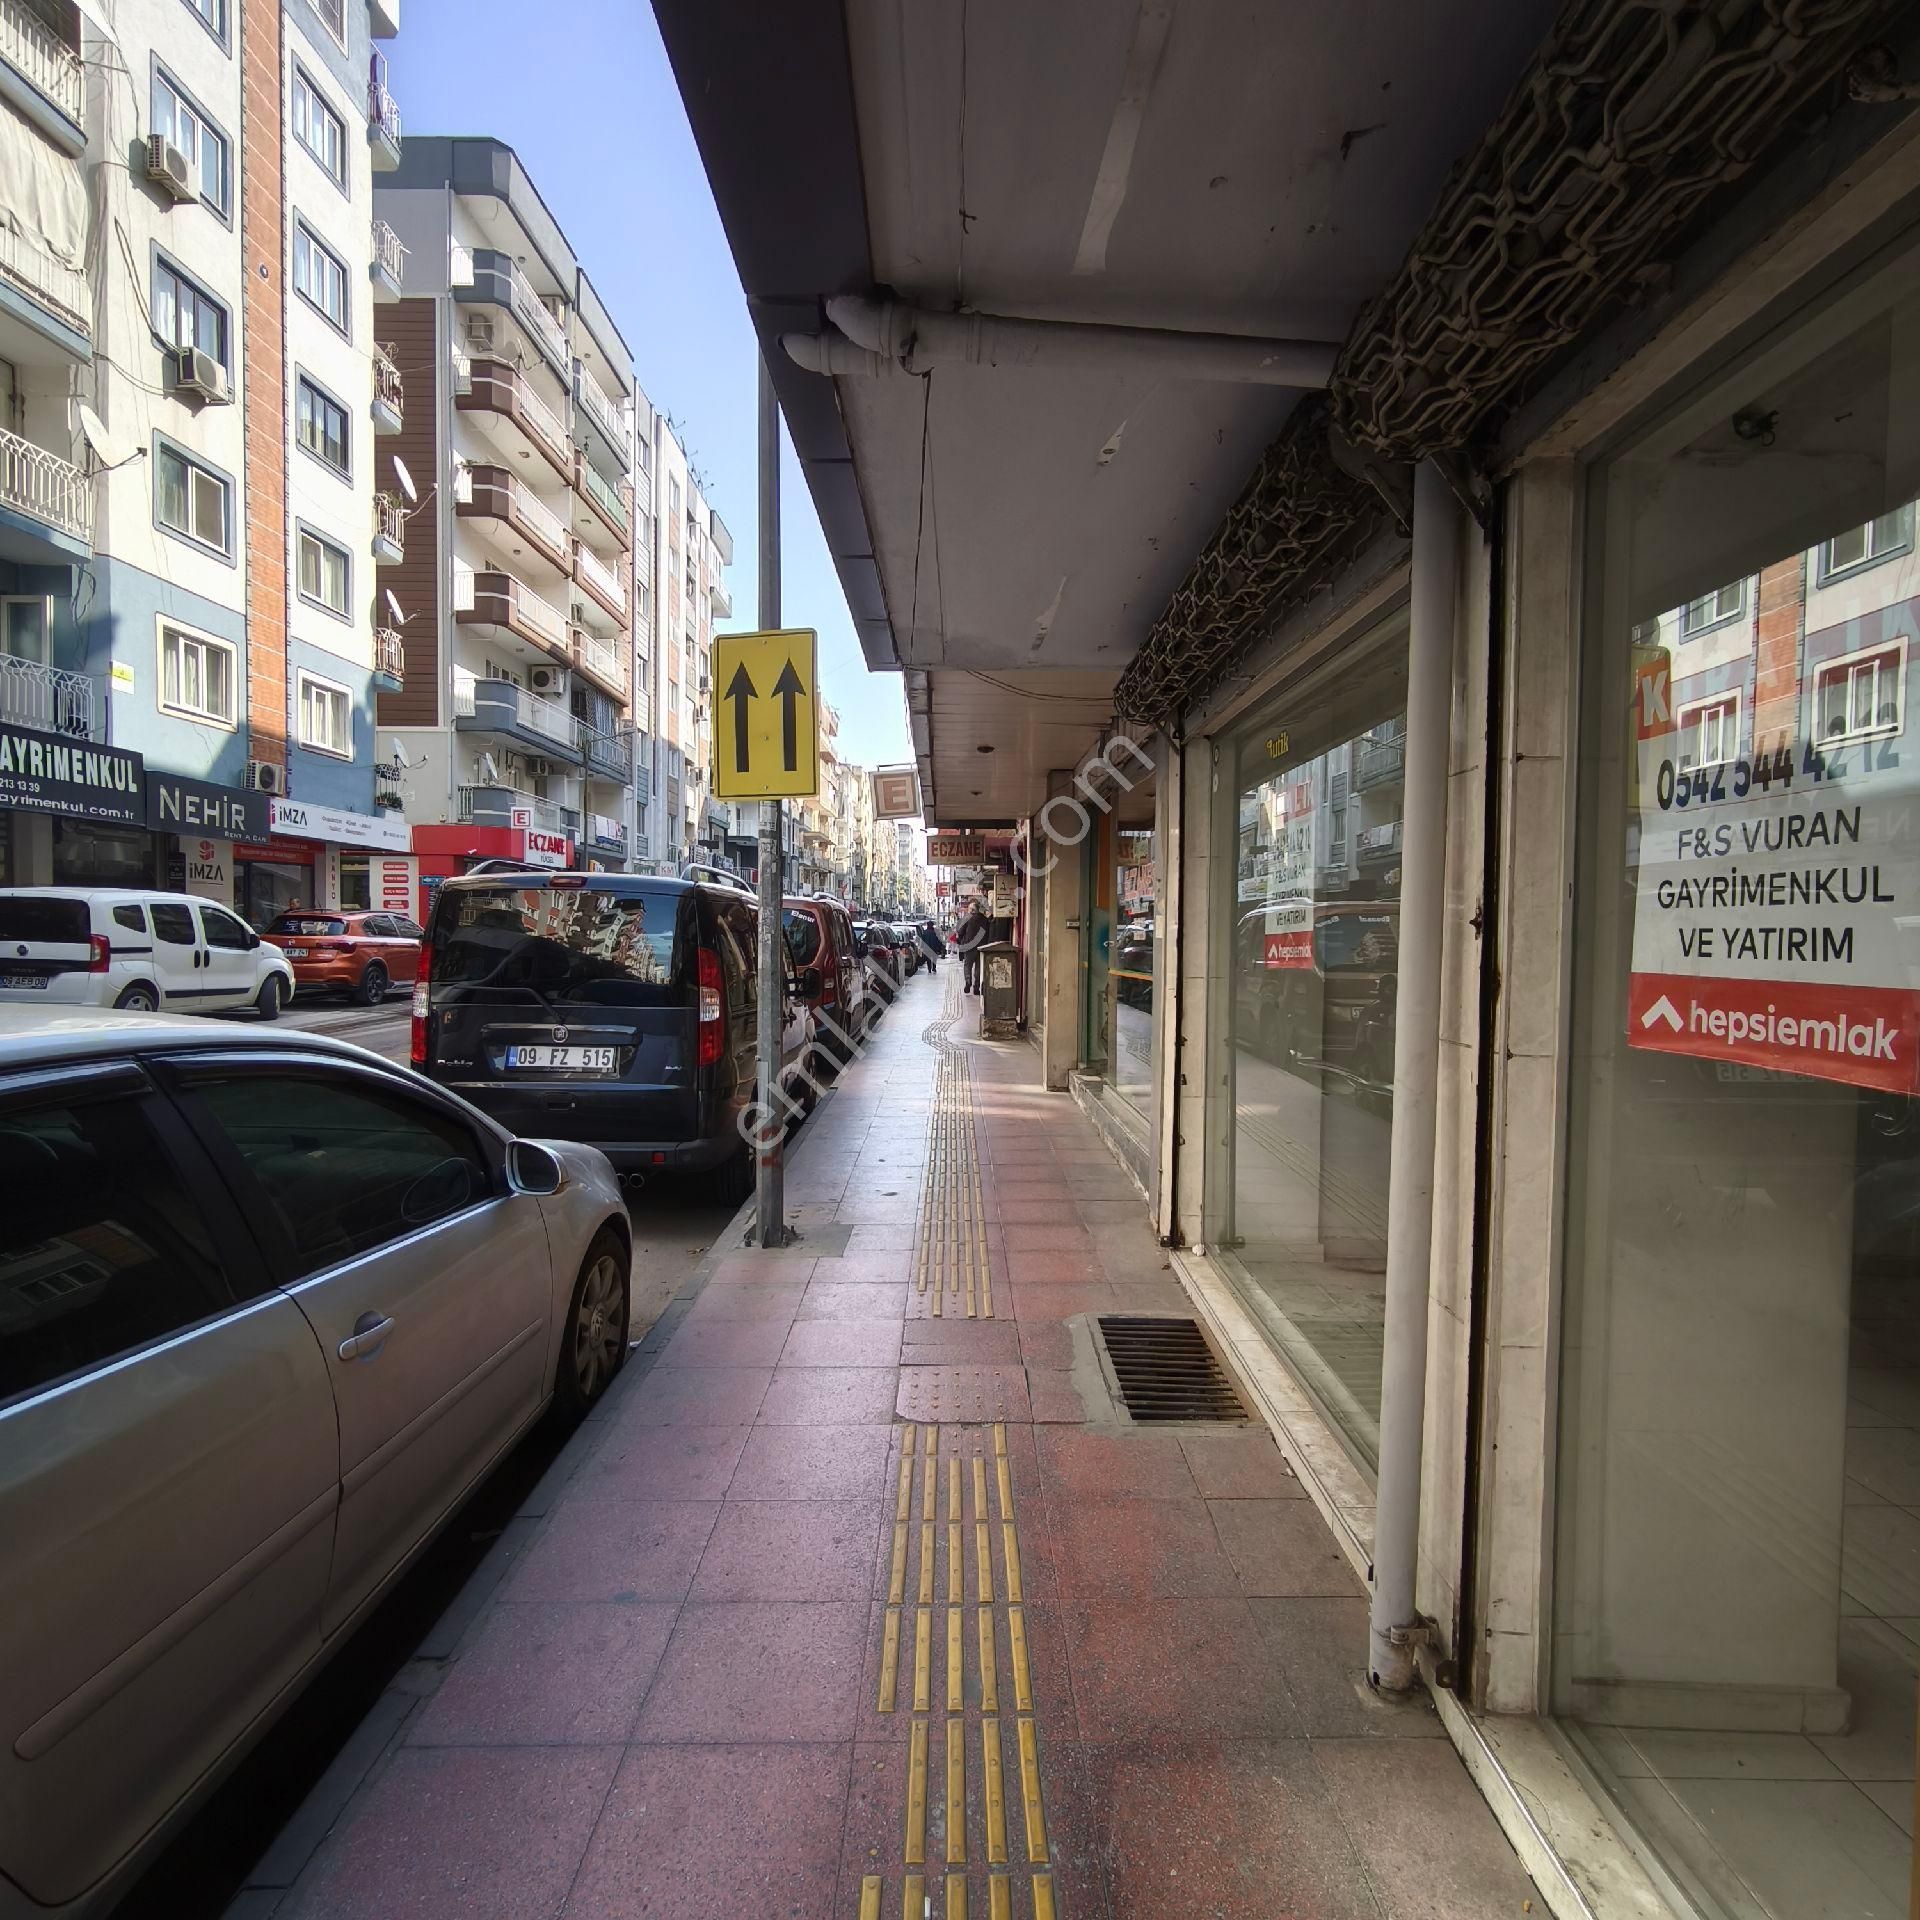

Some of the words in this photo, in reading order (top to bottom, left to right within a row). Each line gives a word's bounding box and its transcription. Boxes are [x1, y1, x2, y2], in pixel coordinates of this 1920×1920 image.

[17, 780, 27, 791] 13
[29, 782, 41, 792] 39
[882, 779, 910, 811] E
[517, 813, 527, 824] E
[225, 830, 242, 839] RENT
[528, 831, 565, 855] ECZANE
[1678, 823, 1732, 860] F&S
[1742, 806, 1861, 853] VURAN
[931, 841, 980, 858] ECZANE
[939, 882, 949, 895] E
[1657, 866, 1895, 909] GAYRİMENKUL
[1679, 927, 1714, 958] VE
[1722, 926, 1854, 963] YATIRIM
[1690, 999, 1899, 1060] hepsiemlak
[518, 1047, 537, 1065] 09
[550, 1048, 569, 1065] FZ
[582, 1049, 612, 1067] 515
